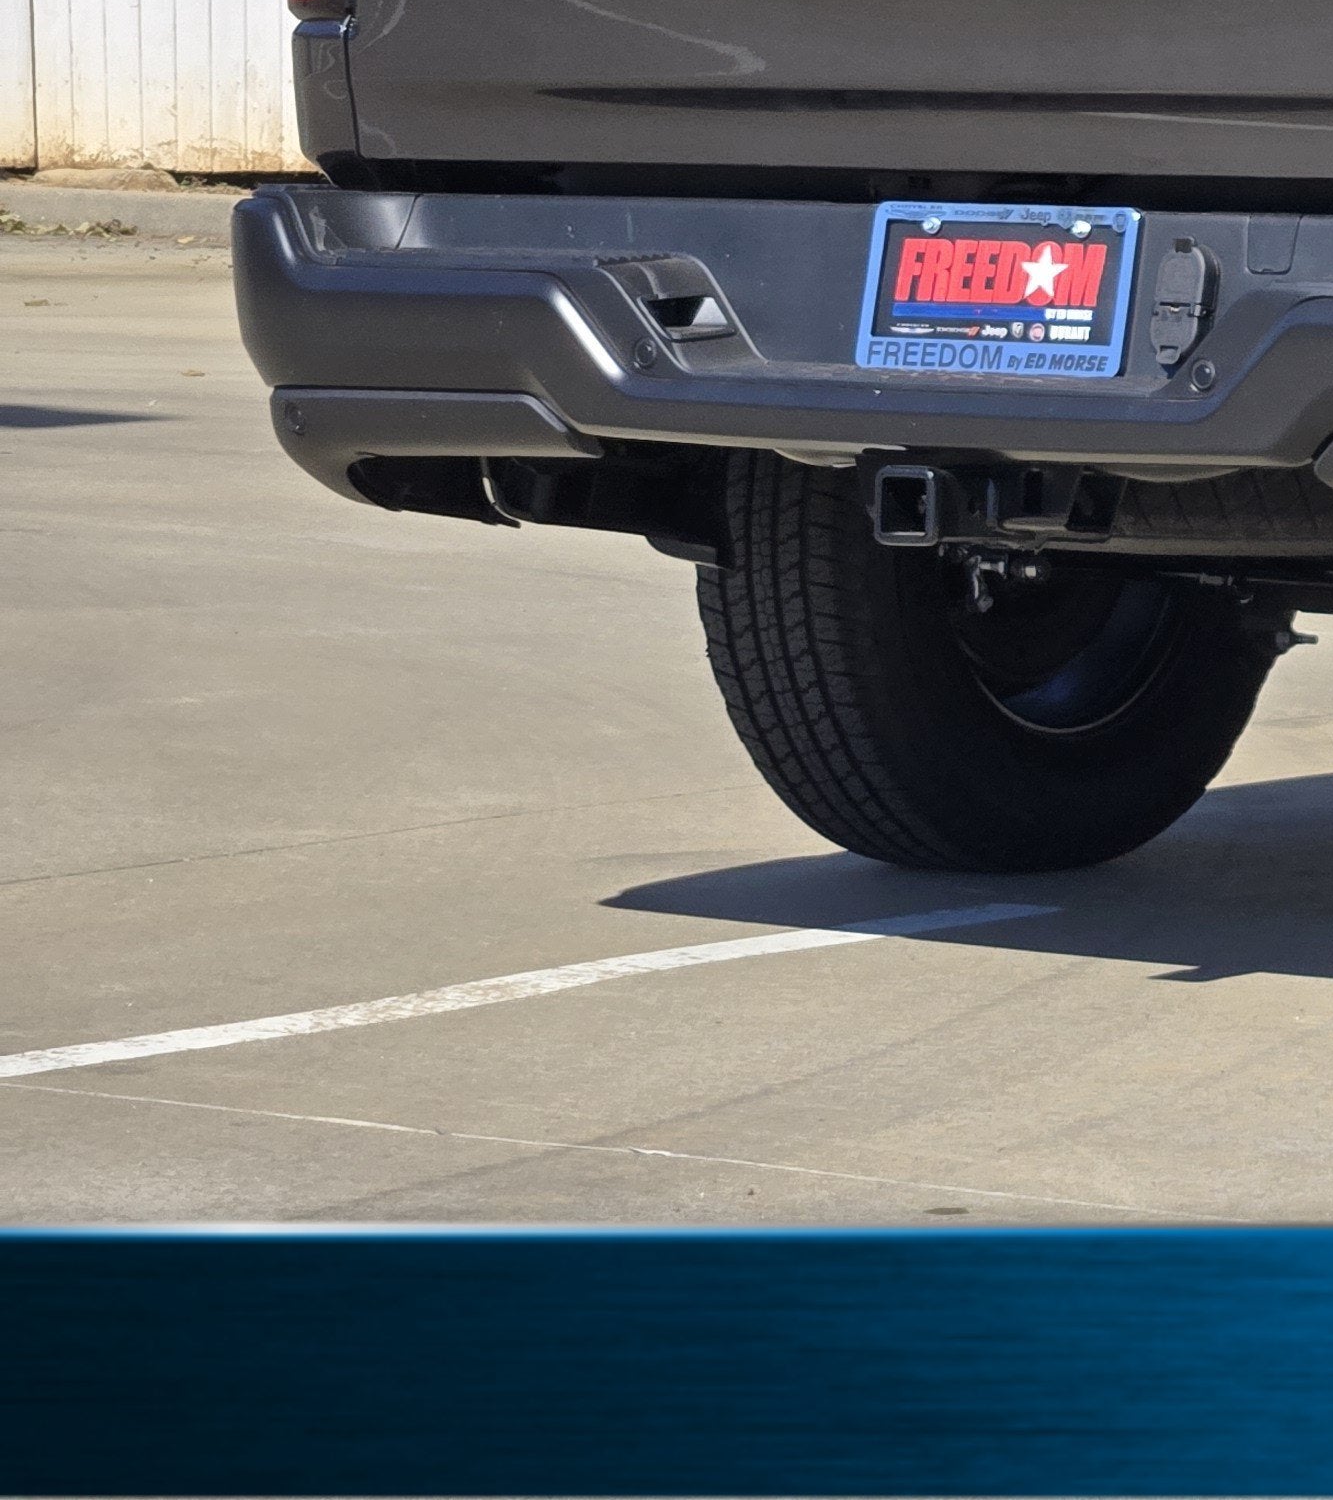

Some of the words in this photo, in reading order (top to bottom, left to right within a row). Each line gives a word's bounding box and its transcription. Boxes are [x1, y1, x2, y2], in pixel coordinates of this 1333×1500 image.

[1021, 206, 1052, 223] Jeep
[894, 238, 1107, 306] FREEDOM
[866, 340, 1004, 370] FREEDOM
[1024, 353, 1047, 369] ED
[1048, 353, 1109, 372] MORSE
